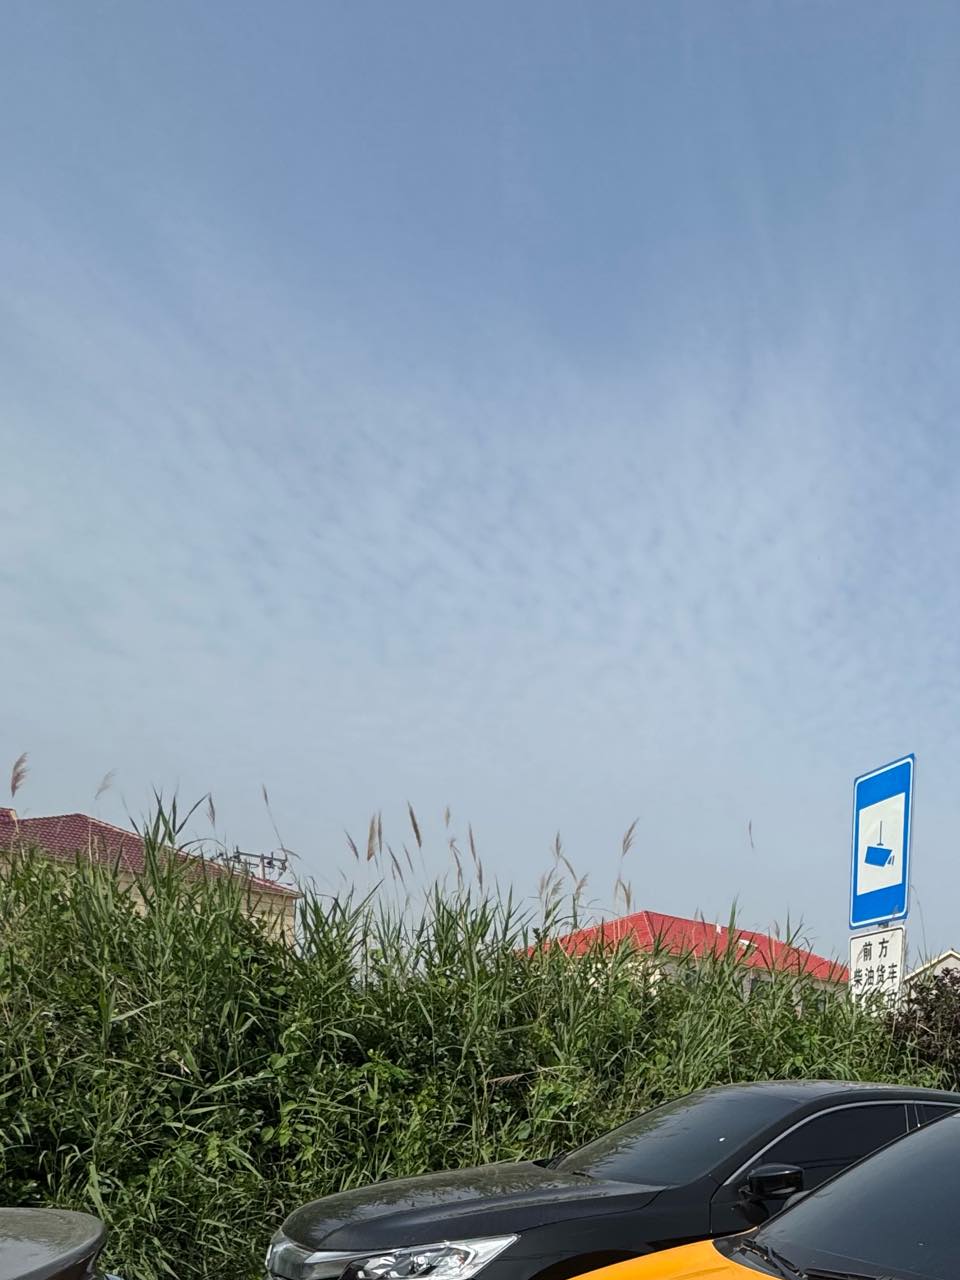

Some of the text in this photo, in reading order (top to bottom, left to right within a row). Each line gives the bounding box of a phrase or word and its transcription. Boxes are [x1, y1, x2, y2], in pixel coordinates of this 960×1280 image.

[863, 938, 889, 961] 前方
[853, 962, 898, 985] 柴油货车
